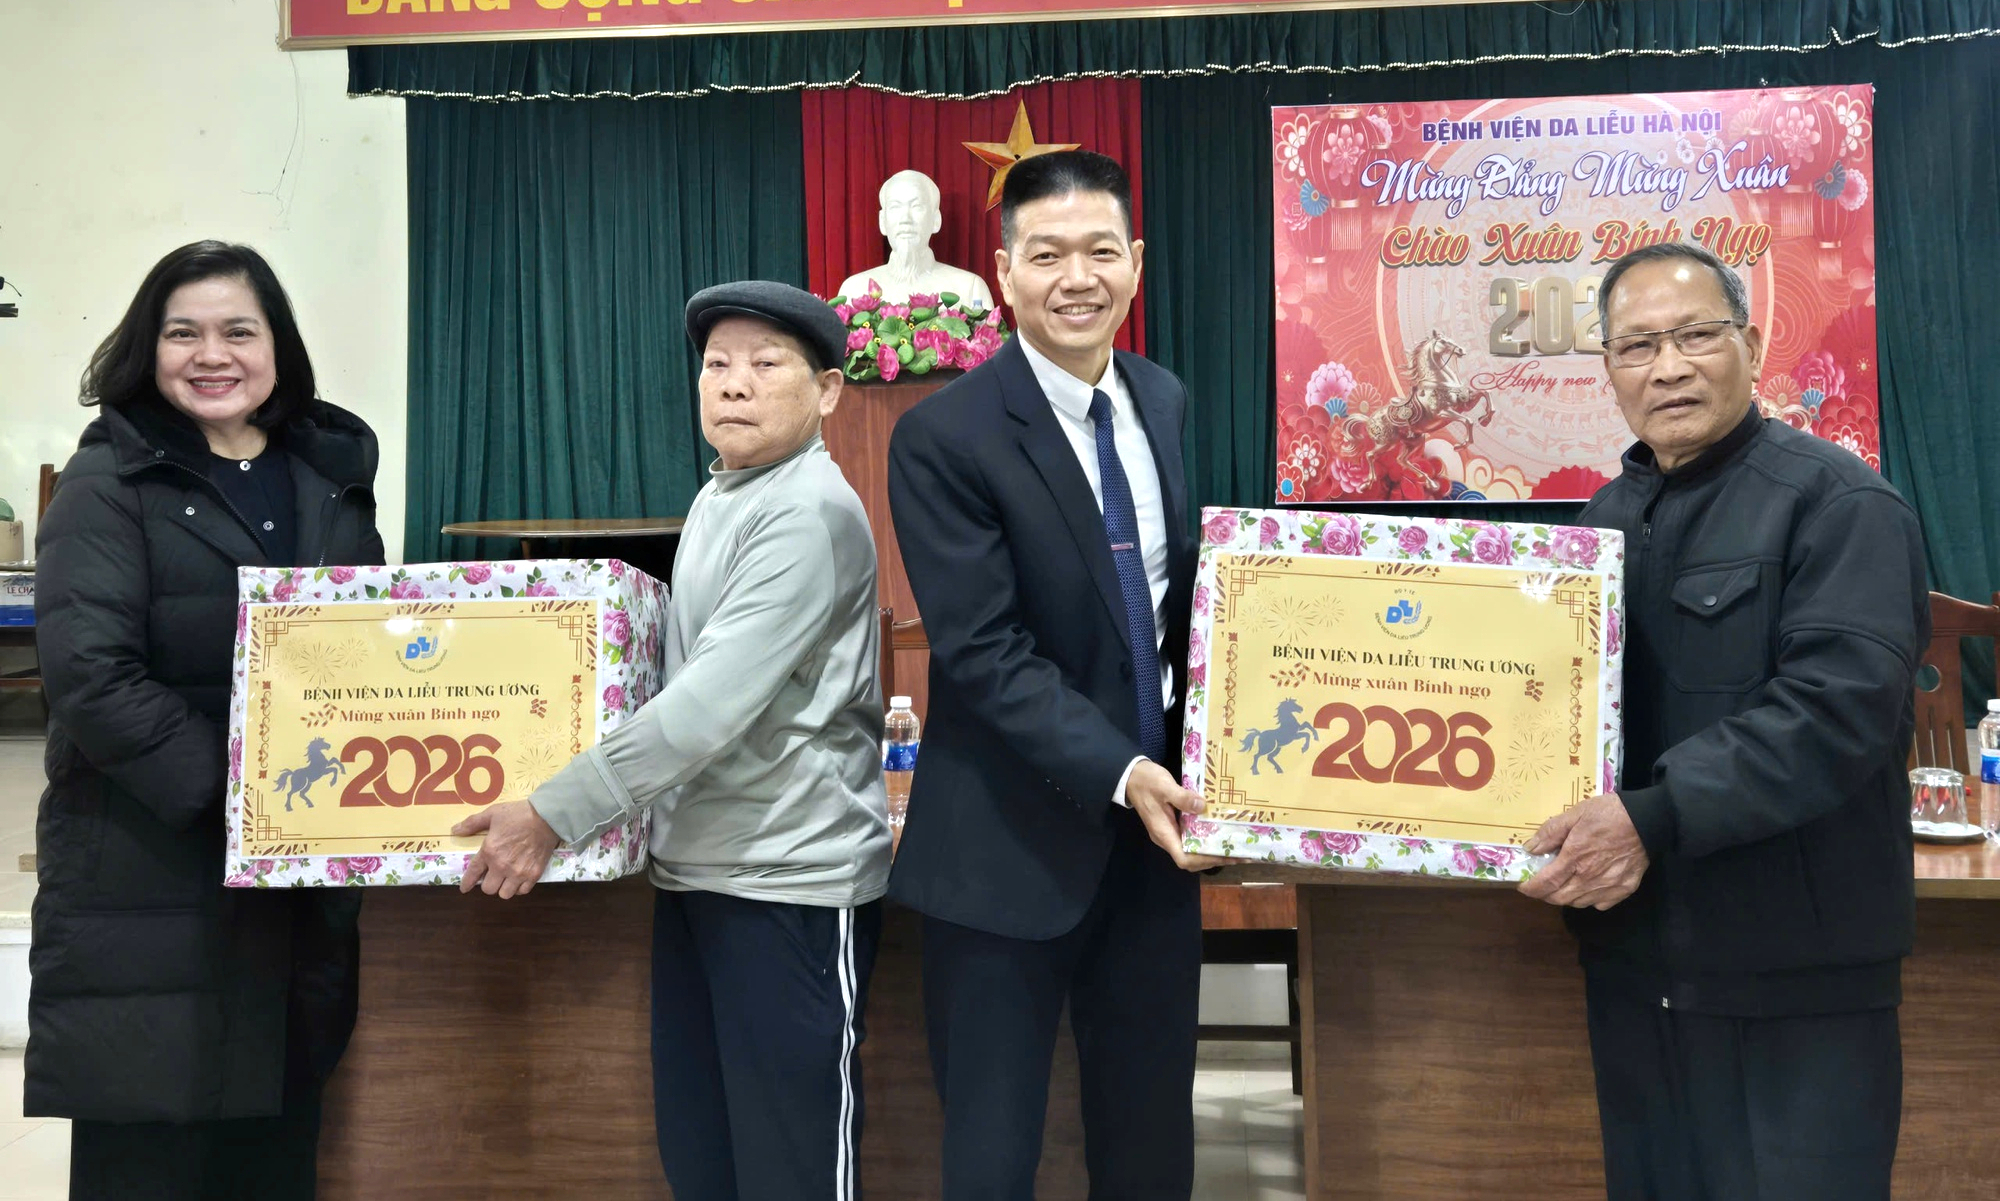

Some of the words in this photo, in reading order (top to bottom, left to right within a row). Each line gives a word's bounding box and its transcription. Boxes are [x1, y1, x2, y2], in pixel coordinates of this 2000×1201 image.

[1422, 118, 1483, 145] BỆNH
[1489, 116, 1541, 142] VIỆN
[1549, 118, 1579, 137] DA
[1586, 109, 1635, 136] LIỄU
[1643, 110, 1674, 134] HÀ
[1681, 108, 1722, 135] NỘI
[1360, 158, 1472, 219] Mừng
[1474, 153, 1566, 216] Đảng
[1572, 150, 1689, 212] Mừng
[1690, 140, 1790, 201] Xuân
[1381, 224, 1472, 268] Chào
[1478, 221, 1584, 266] Xuân
[1691, 215, 1772, 266] Ngọ
[1489, 276, 1605, 357] 202
[1470, 360, 1557, 394] Happy
[1563, 375, 1597, 387] new
[1272, 643, 1315, 661] BỆNH
[1320, 647, 1357, 664] VIỆN
[1363, 651, 1384, 665] DA
[1429, 656, 1484, 672] TRUNG
[1490, 660, 1535, 676] ƯƠNG
[303, 686, 342, 702] BỆNH
[346, 685, 380, 700] VIỆN
[384, 686, 404, 698] DA
[445, 684, 495, 697] TRUNG
[499, 683, 540, 696] ƯƠNG
[1312, 671, 1362, 690] Mừng
[1366, 676, 1408, 692] xuân
[1414, 679, 1453, 694] Bính
[1459, 684, 1491, 699] ngọ
[340, 709, 384, 724] Mừng
[388, 709, 426, 721] xuân
[431, 707, 467, 720] Bính
[471, 709, 501, 722] ngọ
[1311, 702, 1496, 791] 2026
[340, 733, 505, 808] 2026
